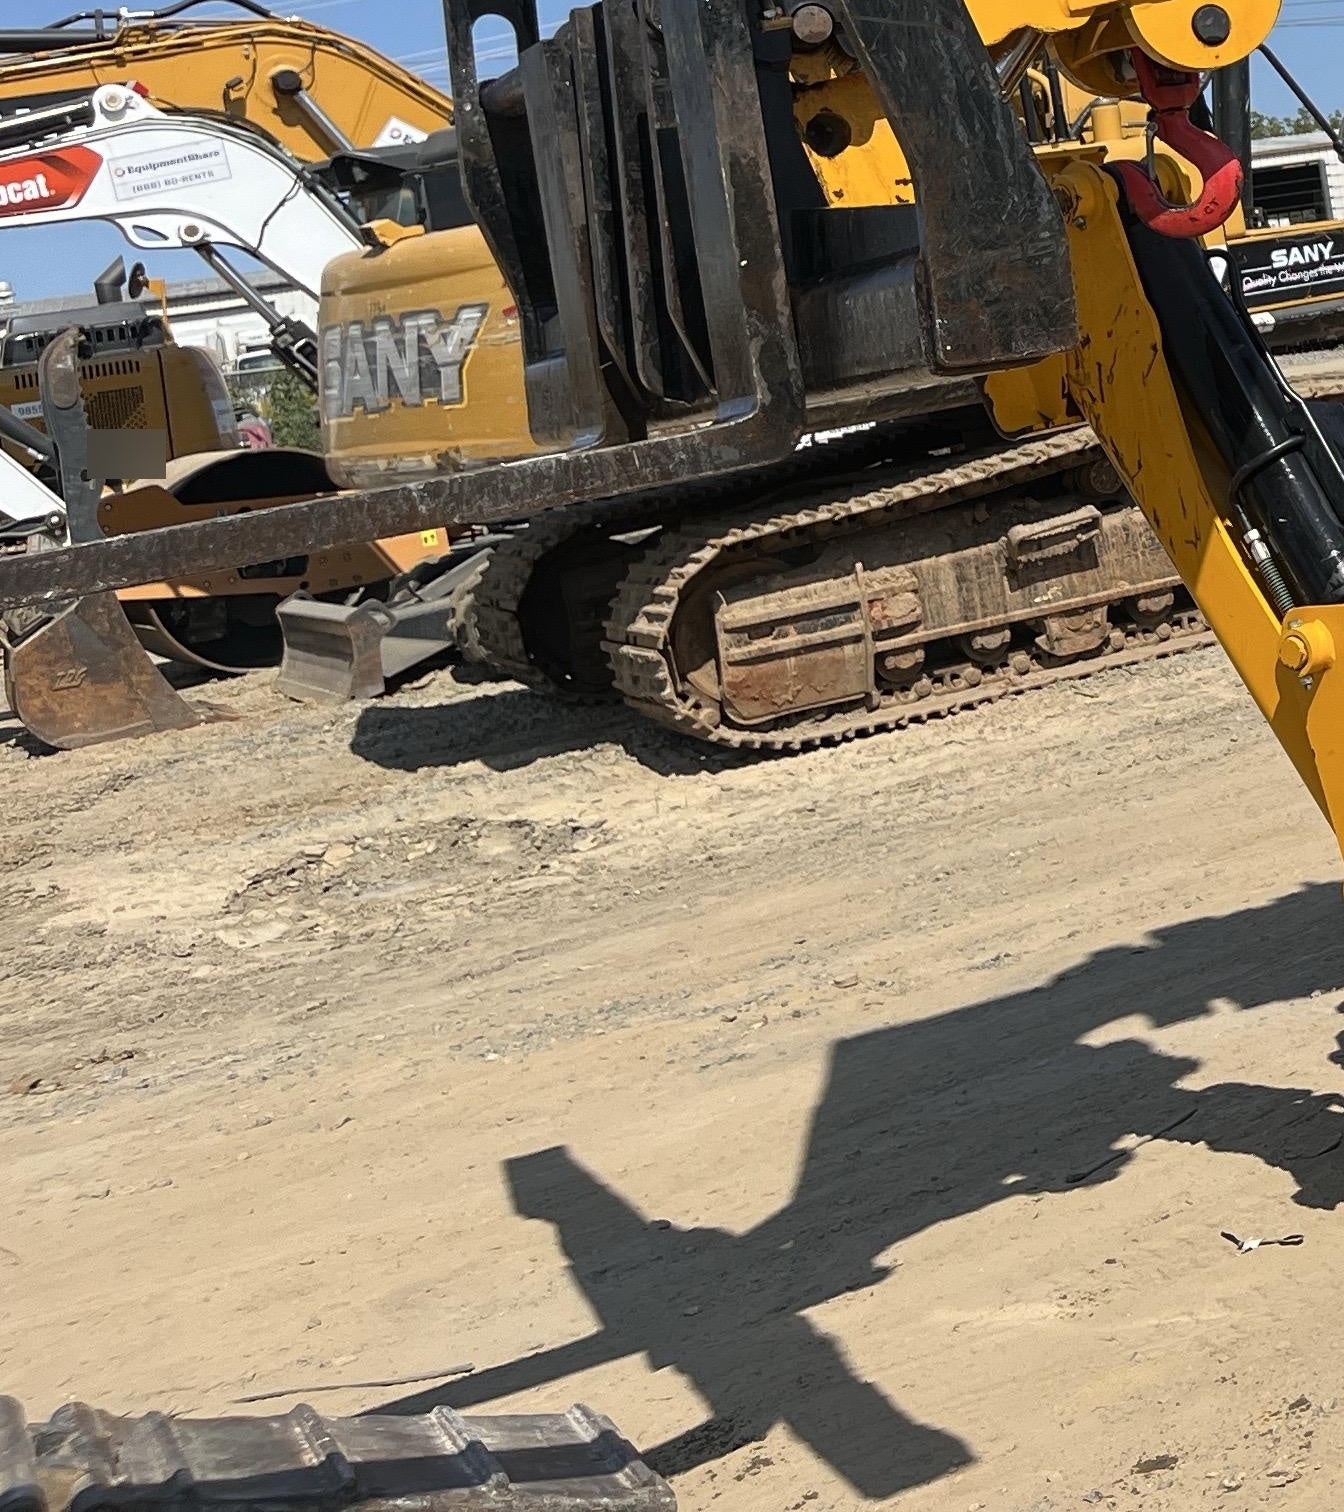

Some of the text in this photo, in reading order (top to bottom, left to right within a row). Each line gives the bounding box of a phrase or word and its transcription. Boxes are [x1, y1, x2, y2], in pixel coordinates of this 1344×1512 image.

[127, 149, 220, 175] EquipmentShare
[1271, 241, 1334, 269] SANY
[1242, 273, 1277, 291] Quality
[1278, 267, 1318, 281] Changes
